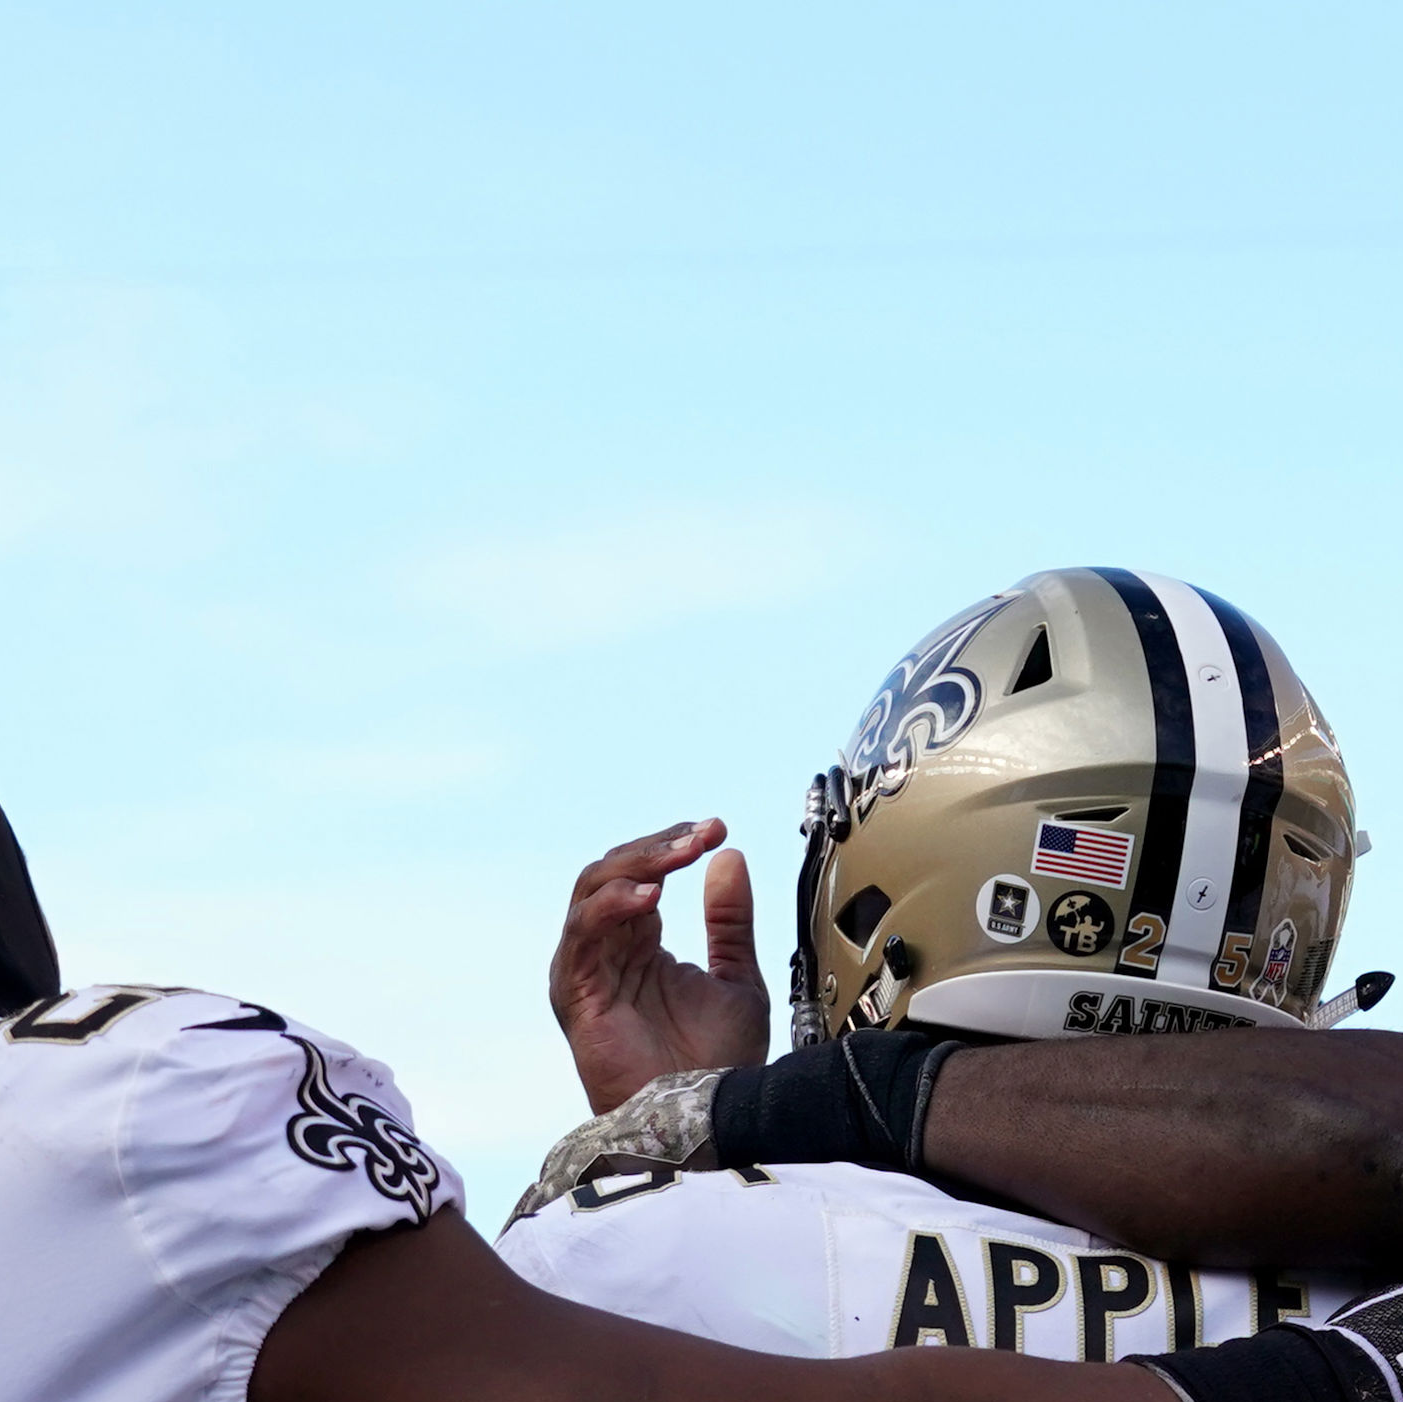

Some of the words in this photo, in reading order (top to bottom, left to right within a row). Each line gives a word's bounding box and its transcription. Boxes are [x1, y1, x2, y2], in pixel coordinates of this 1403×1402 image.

[1059, 925, 1098, 953] TB
[1119, 911, 1167, 971] 2
[1213, 931, 1254, 988] 5
[1265, 961, 1286, 981] NFL
[1063, 990, 1257, 1036] SAINT
